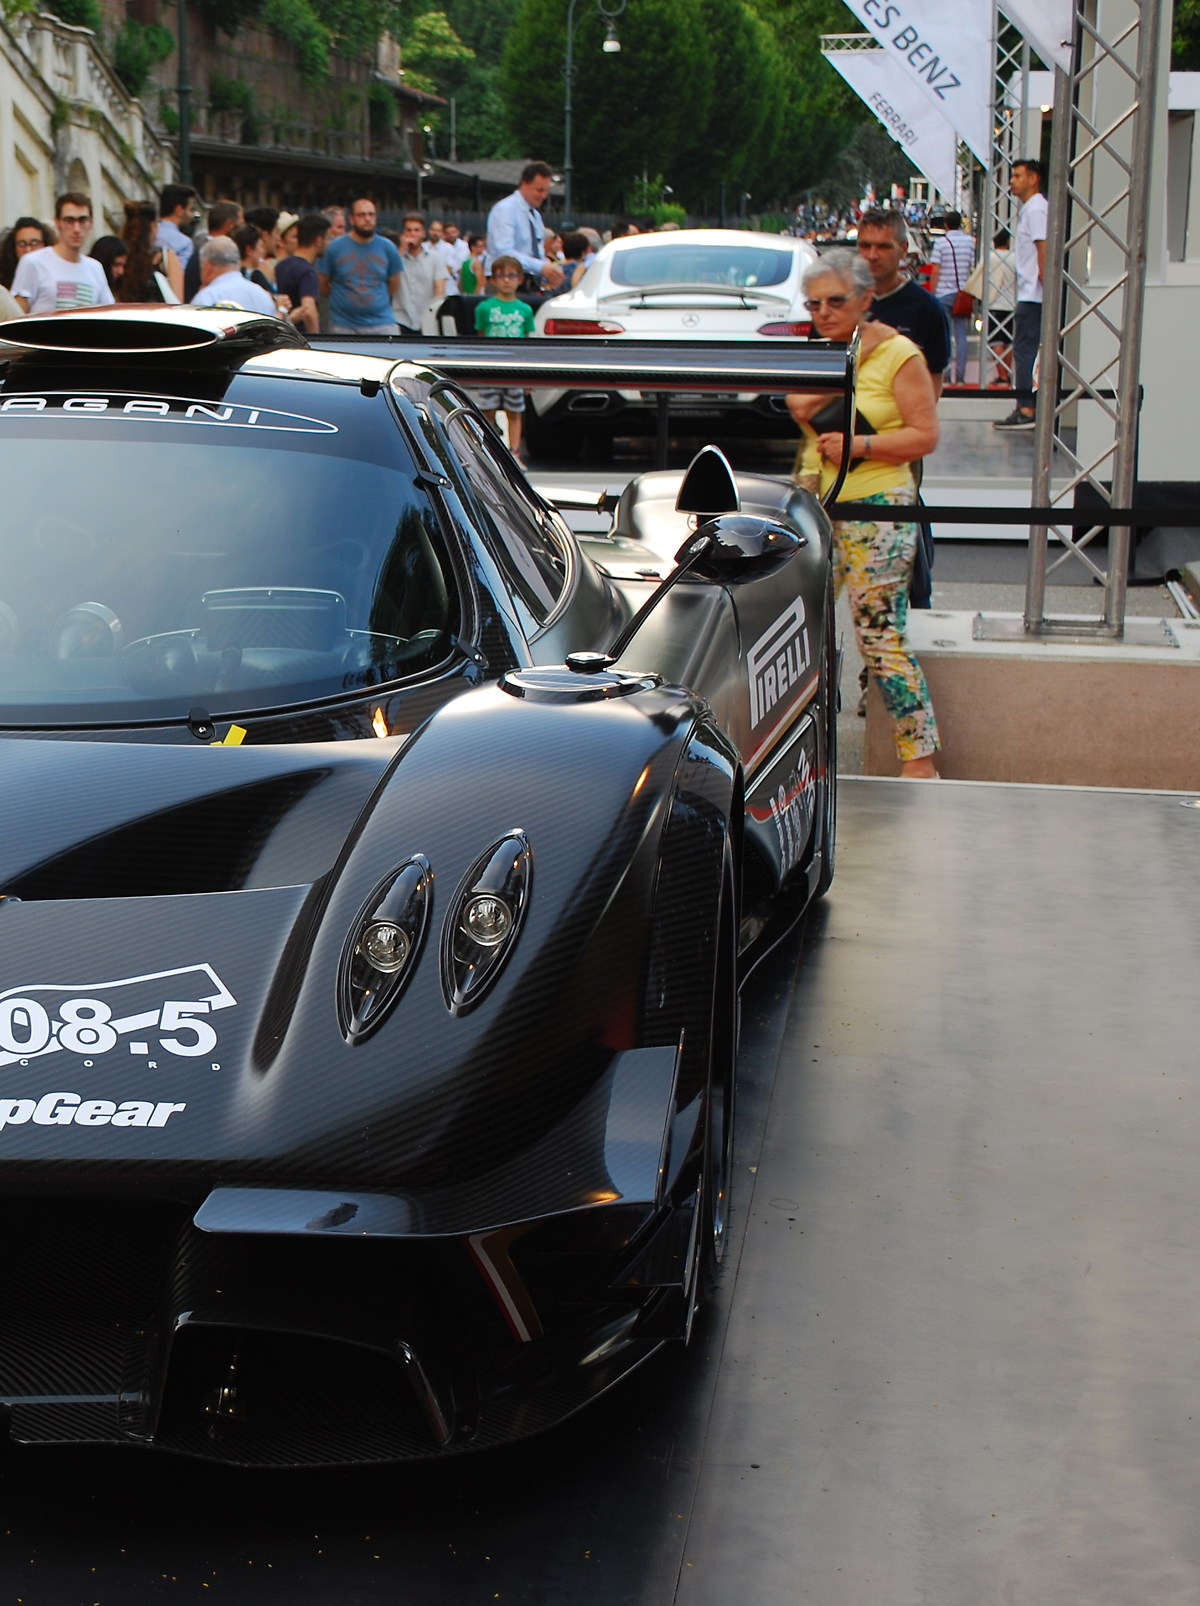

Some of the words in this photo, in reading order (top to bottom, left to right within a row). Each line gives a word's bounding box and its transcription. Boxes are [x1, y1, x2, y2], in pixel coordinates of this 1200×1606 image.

[892, 25, 961, 100] BENZ
[868, 92, 919, 146] FERRARI
[746, 596, 812, 730] PIRELLI
